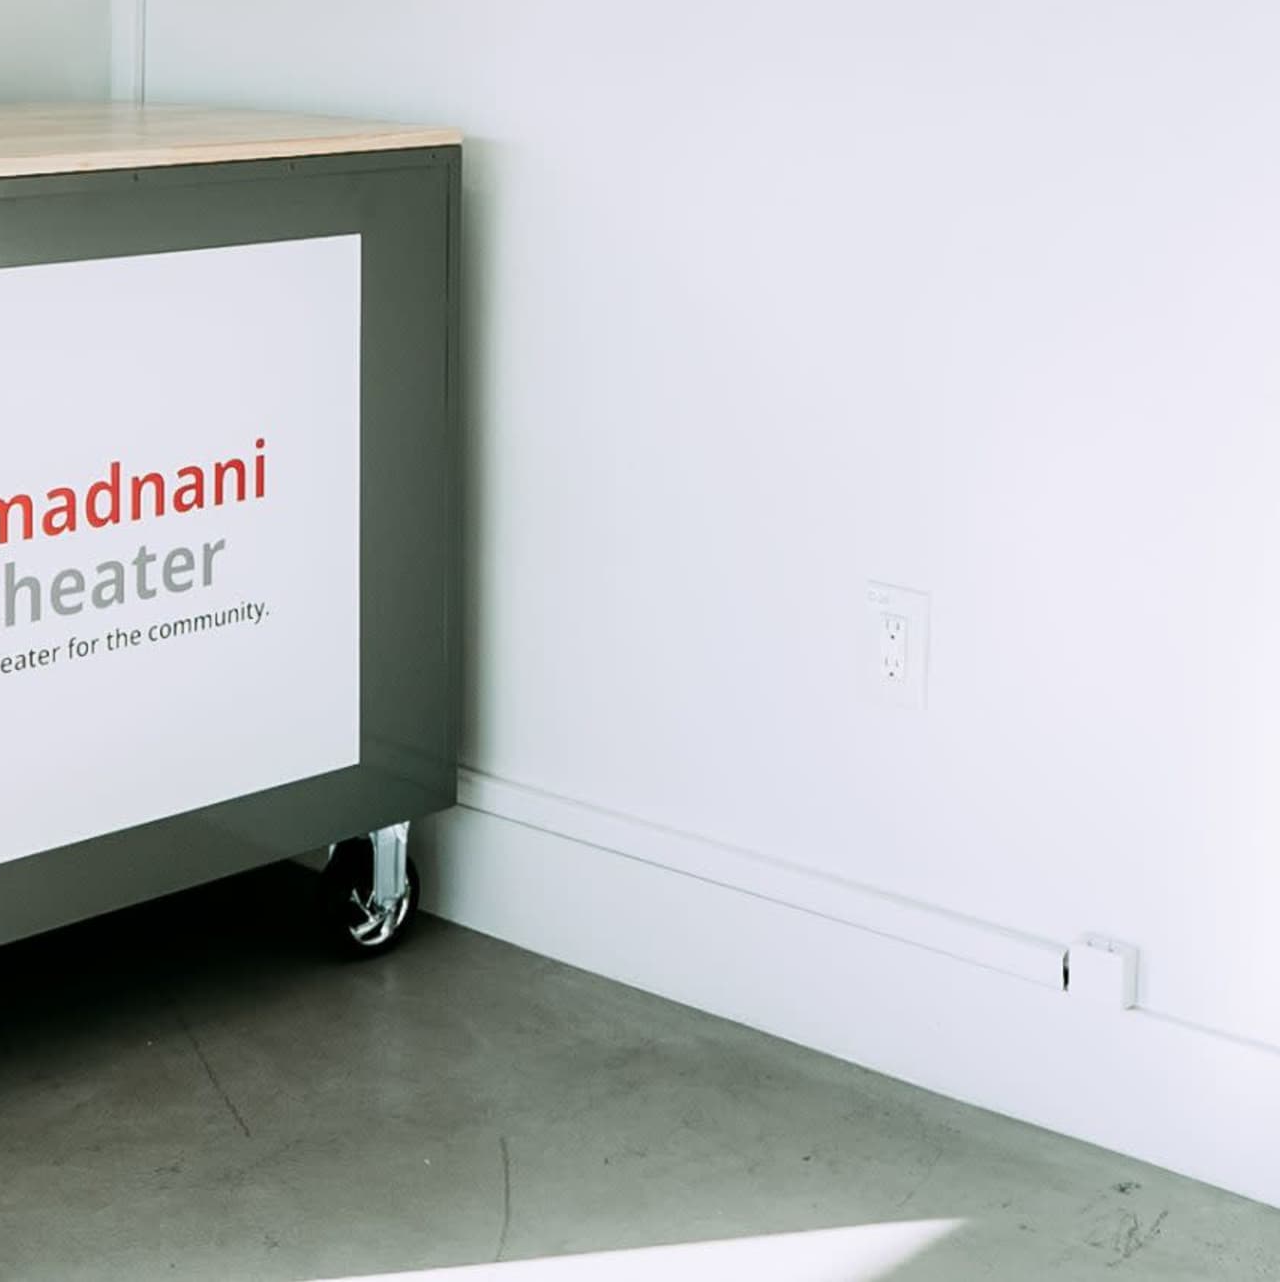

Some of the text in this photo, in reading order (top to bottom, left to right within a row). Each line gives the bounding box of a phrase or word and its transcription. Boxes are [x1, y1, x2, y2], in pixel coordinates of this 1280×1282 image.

[67, 632, 101, 660] for
[105, 623, 143, 651] the
[147, 602, 272, 644] community.
